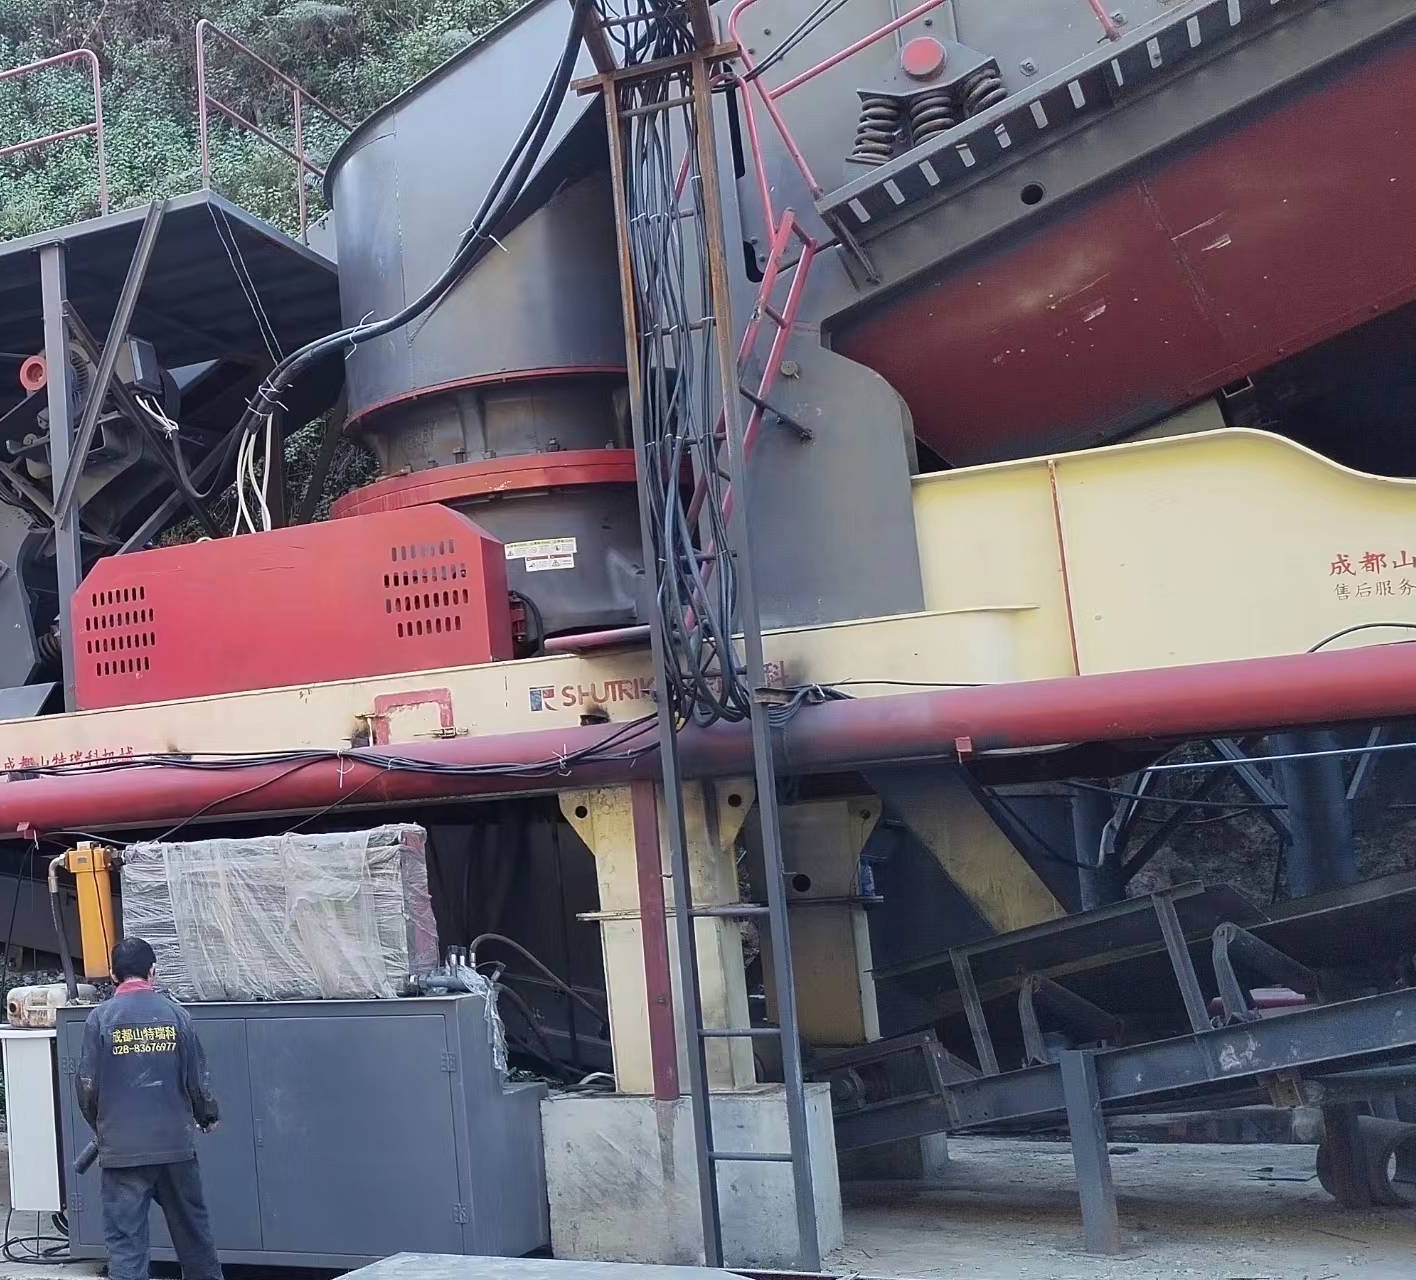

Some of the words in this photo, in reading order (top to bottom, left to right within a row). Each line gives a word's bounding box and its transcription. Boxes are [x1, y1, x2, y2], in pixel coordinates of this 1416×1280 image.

[1329, 550, 1416, 576] 成都山
[1335, 579, 1416, 601] 售后服务
[112, 1026, 176, 1043] 成都山特瑞科
[112, 1042, 176, 1055] 028-83676977
